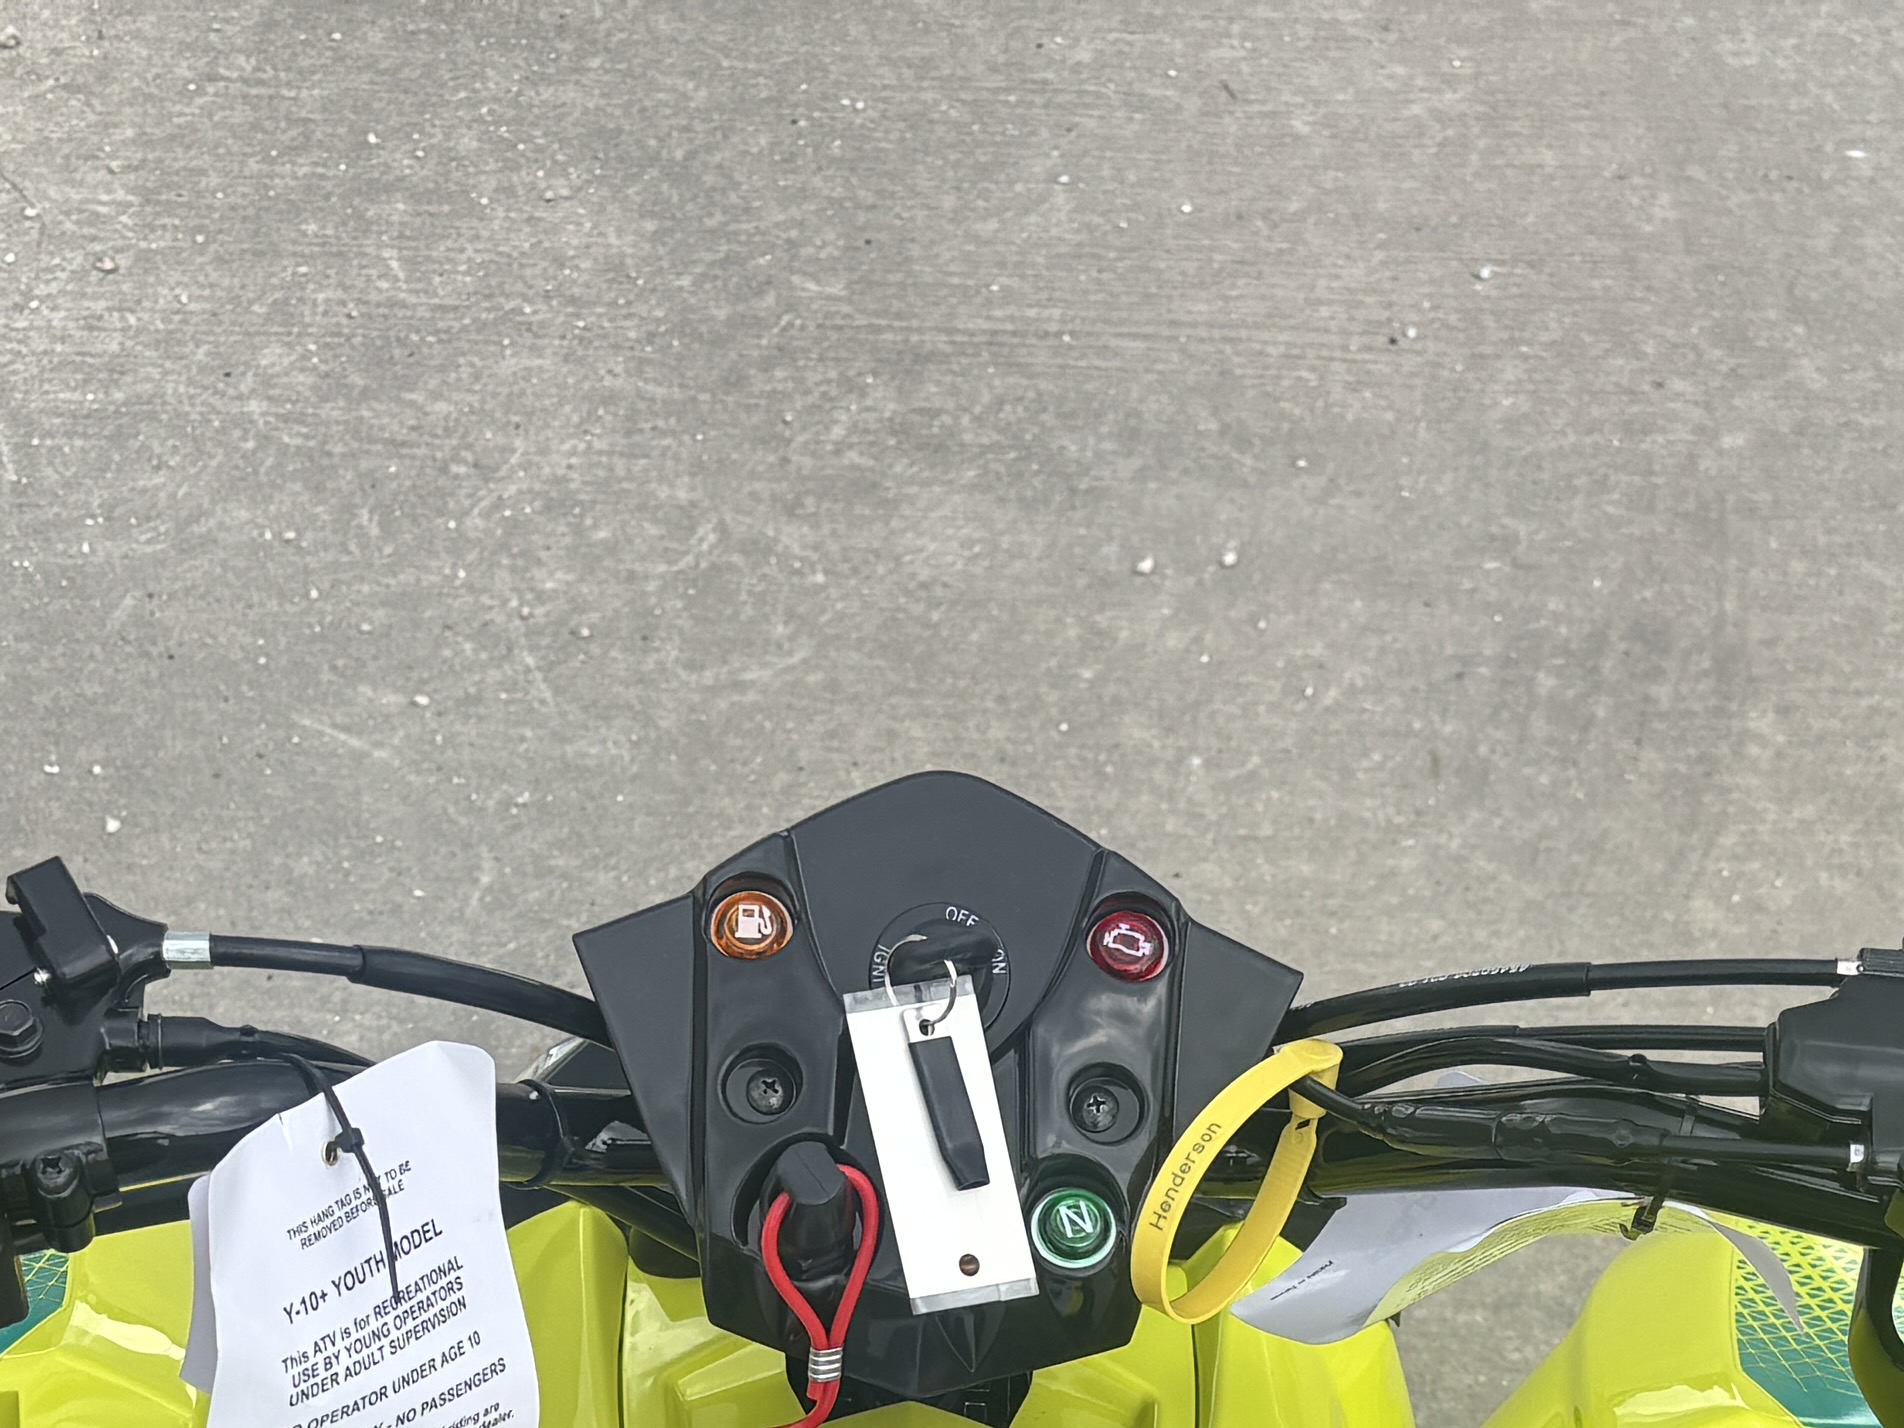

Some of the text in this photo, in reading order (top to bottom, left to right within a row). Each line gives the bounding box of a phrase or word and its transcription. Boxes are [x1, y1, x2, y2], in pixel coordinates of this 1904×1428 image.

[946, 906, 979, 927] OFF
[286, 1221, 309, 1240] THIS
[310, 1205, 336, 1228] HANG
[335, 1194, 353, 1212] TAG
[353, 1187, 362, 1200] IS
[384, 1169, 398, 1183] TO
[398, 1160, 412, 1173] BE
[1149, 1122, 1223, 1231] Henderson
[300, 1216, 344, 1250] REMOVED
[1057, 1200, 1094, 1238] N
[281, 1255, 464, 1374] This ATV is for RECREATIONAL
[283, 1289, 328, 1325] Y-10+
[331, 1250, 386, 1298] YOUTH
[288, 1295, 467, 1407] UNDER ADULT SUPERVISION
[292, 1275, 464, 1389] USE BY YOUNG OPERATORS
[392, 1357, 438, 1395] UNDER
[440, 1337, 466, 1375] AGE
[467, 1330, 482, 1353] 10
[395, 1407, 417, 1428] NO
[420, 1357, 507, 1417] PASSENGERS
